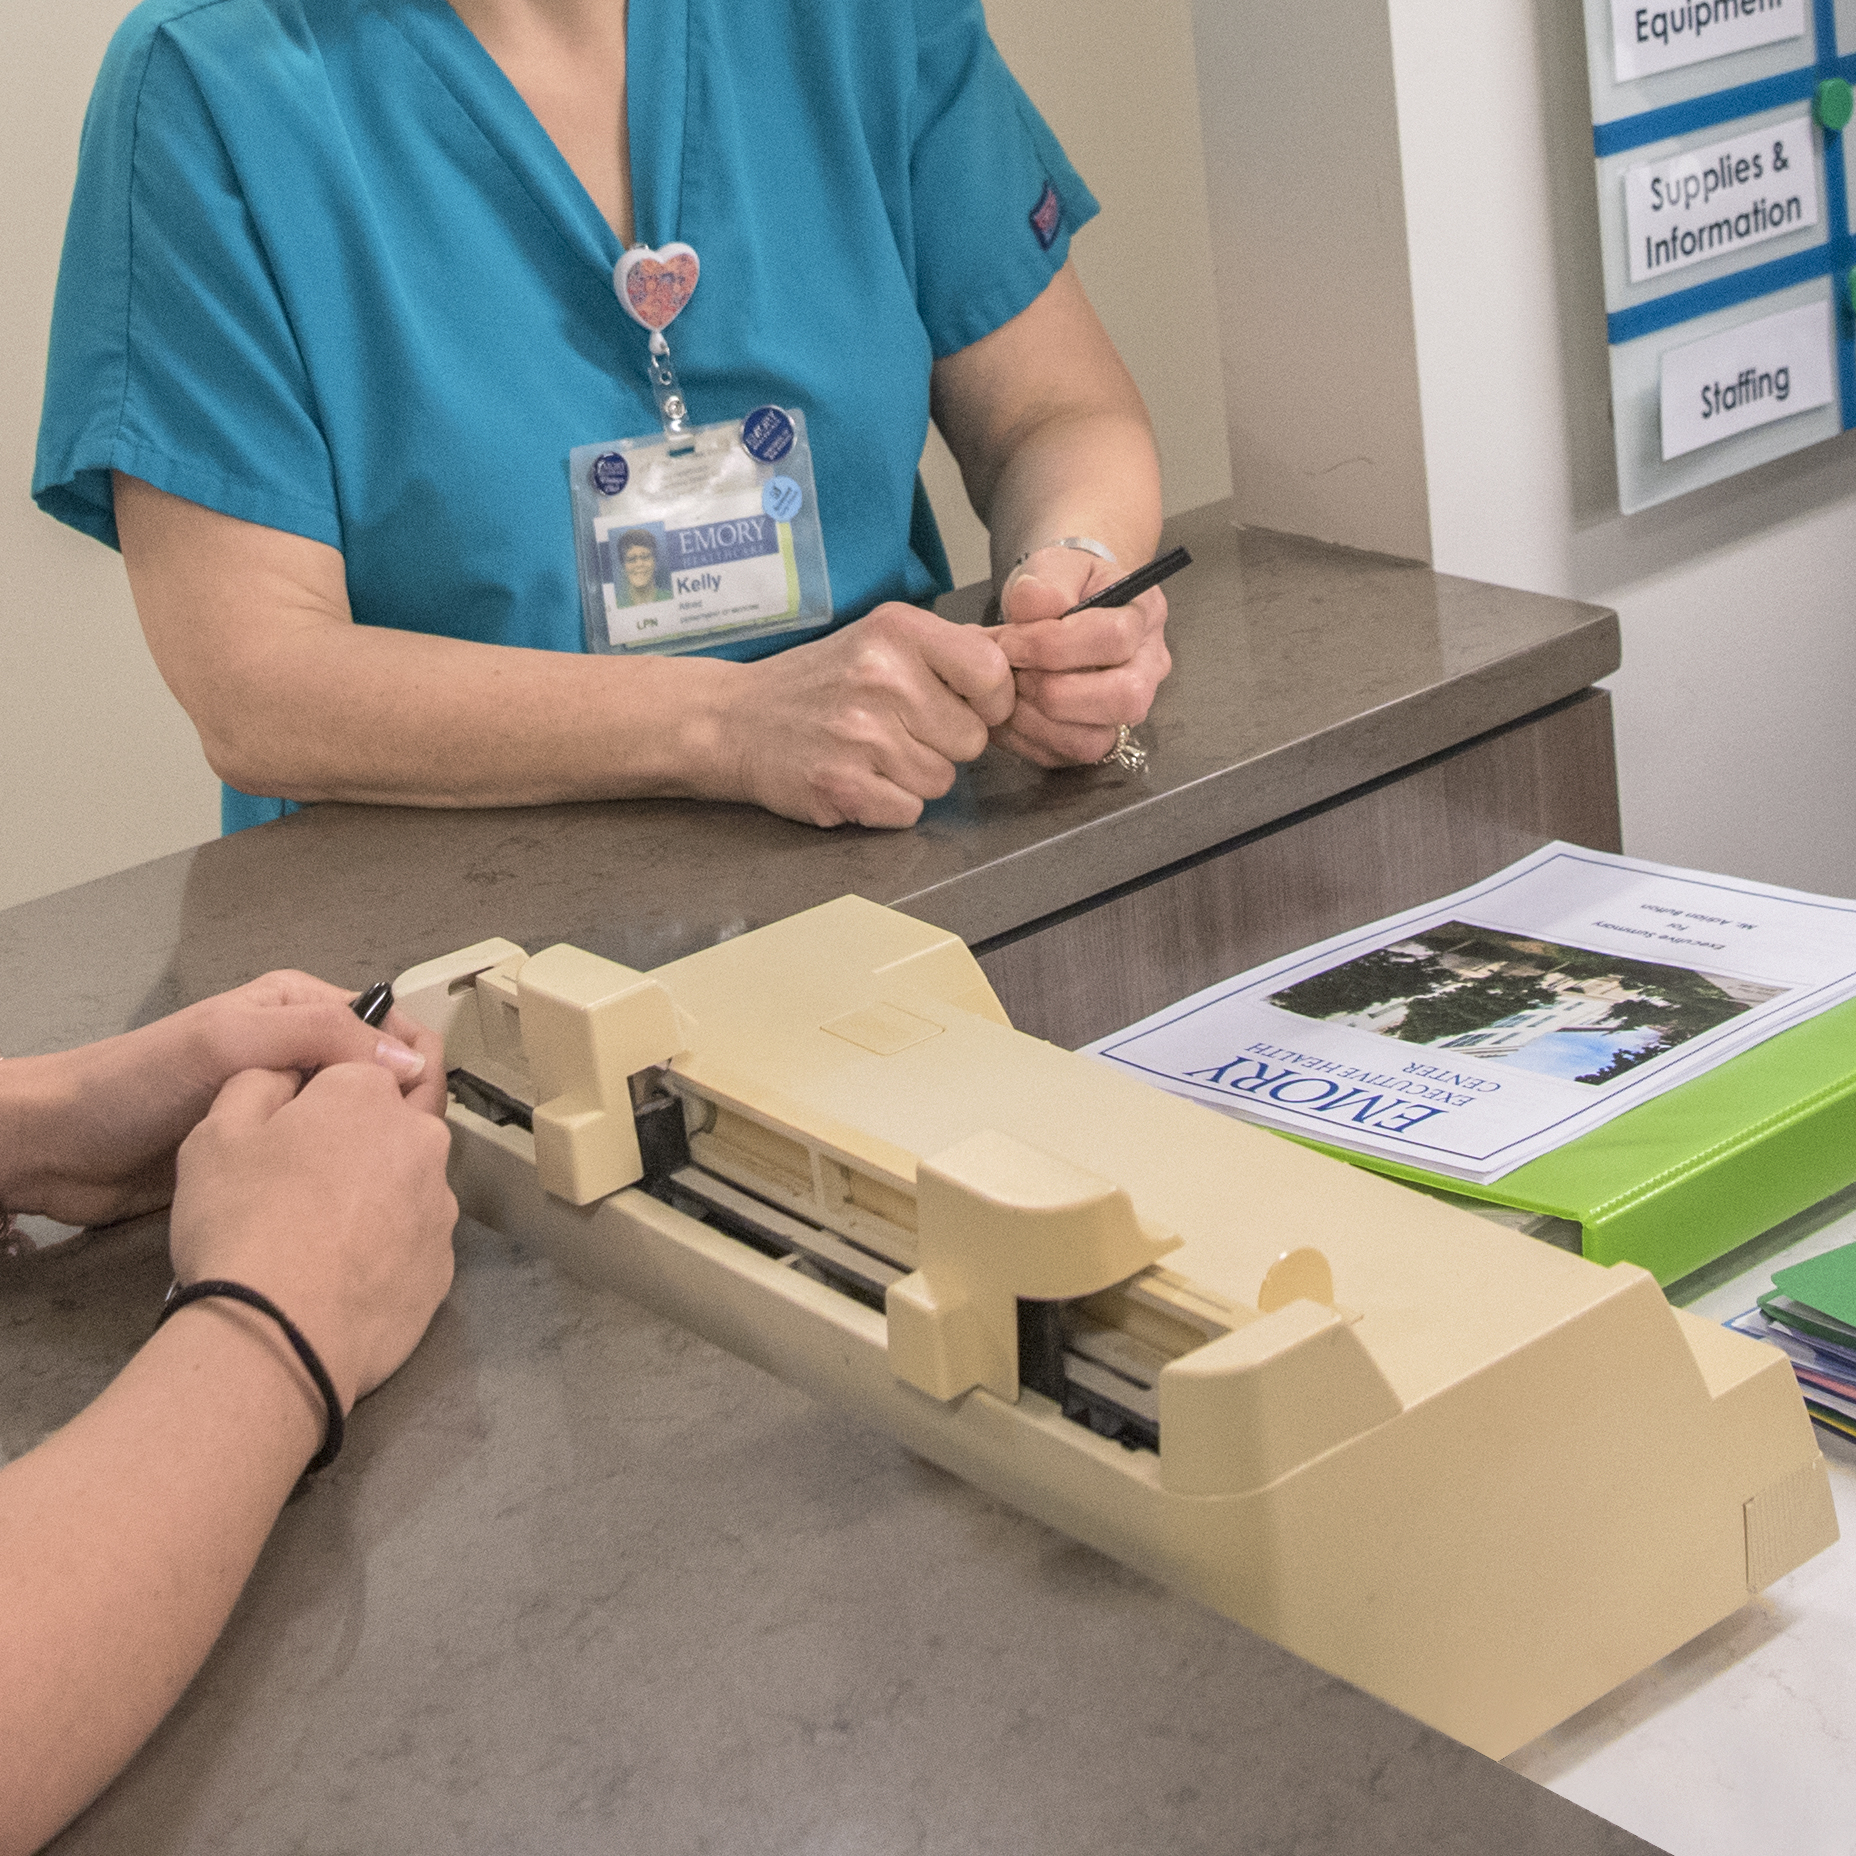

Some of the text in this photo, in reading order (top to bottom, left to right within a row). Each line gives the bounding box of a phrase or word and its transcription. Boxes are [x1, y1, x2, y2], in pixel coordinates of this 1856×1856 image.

[1649, 140, 1790, 213] Supplies &
[1644, 192, 1802, 271] Information
[1699, 362, 1792, 420] Staffing
[678, 516, 769, 556] EMORY
[681, 542, 767, 569] HEALTHCARE
[676, 570, 722, 597] Kelly
[636, 615, 659, 630] LPN
[1590, 919, 1727, 953] Executive Summary
[1184, 1053, 1449, 1136] EMORY
[1244, 1040, 1476, 1109] EXECUTIVE HEALTH
[1401, 1060, 1502, 1096] CENTER
